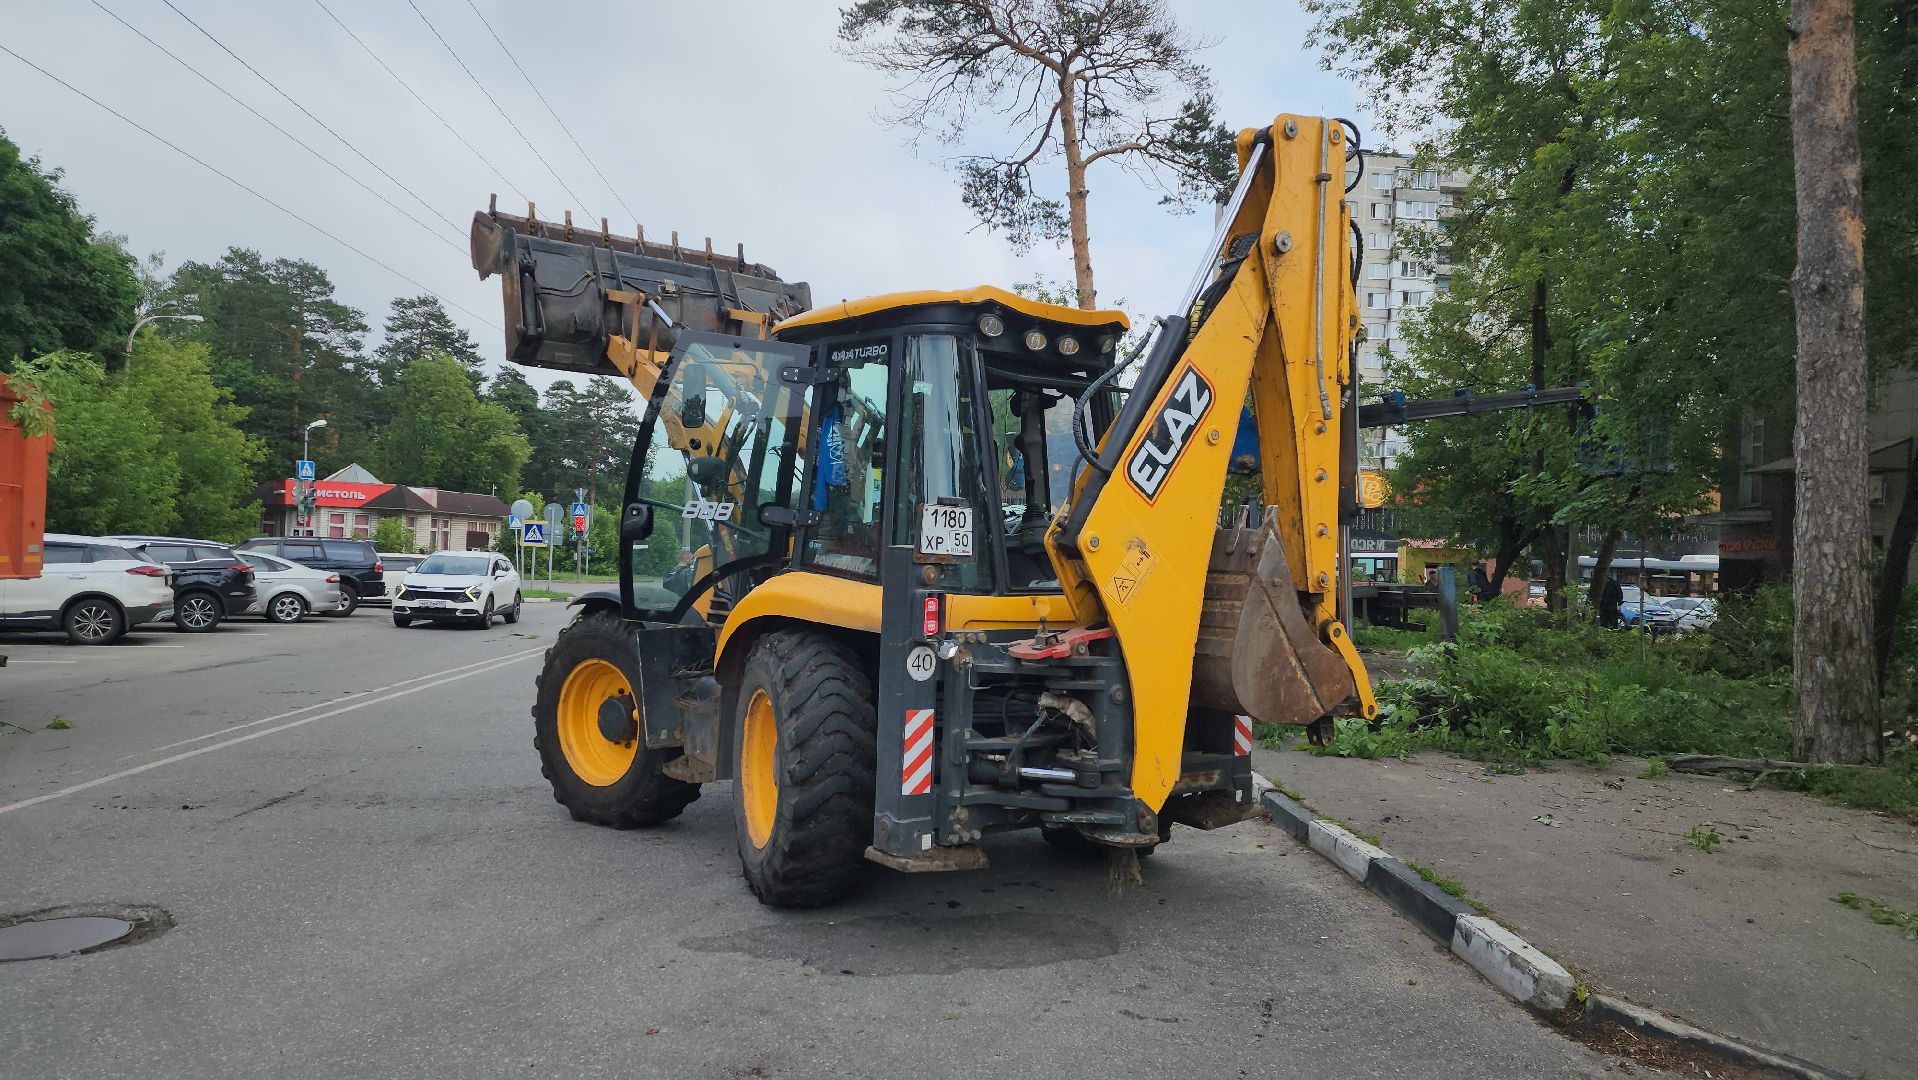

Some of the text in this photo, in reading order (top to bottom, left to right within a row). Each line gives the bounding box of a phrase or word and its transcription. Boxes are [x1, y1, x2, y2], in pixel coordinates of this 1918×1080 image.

[1130, 370, 1210, 496] ELAZ
[930, 508, 967, 529] 1180
[954, 532, 969, 547] 50
[911, 653, 933, 672] 40
